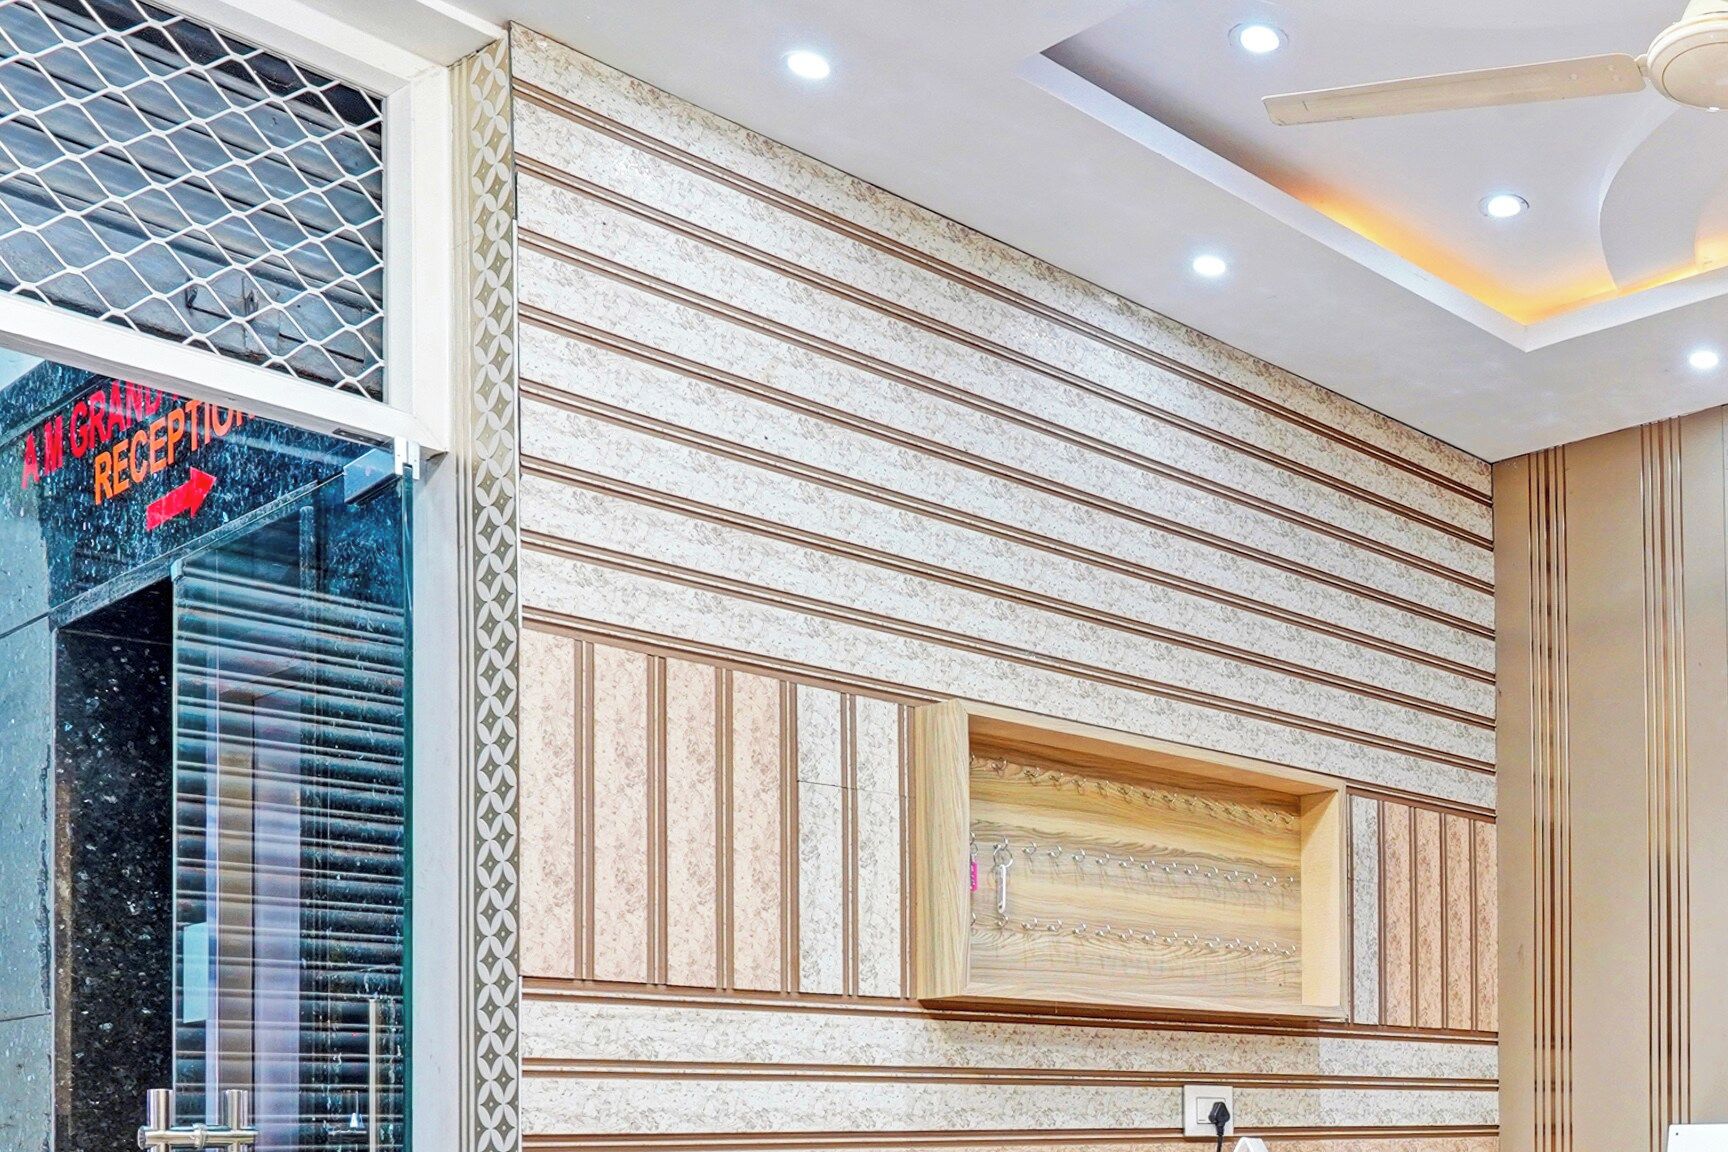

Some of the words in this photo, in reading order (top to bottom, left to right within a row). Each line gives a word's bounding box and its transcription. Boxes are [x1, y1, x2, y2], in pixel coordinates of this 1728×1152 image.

[21, 431, 41, 490] A
[43, 414, 64, 476] M
[70, 380, 162, 458] GRAND
